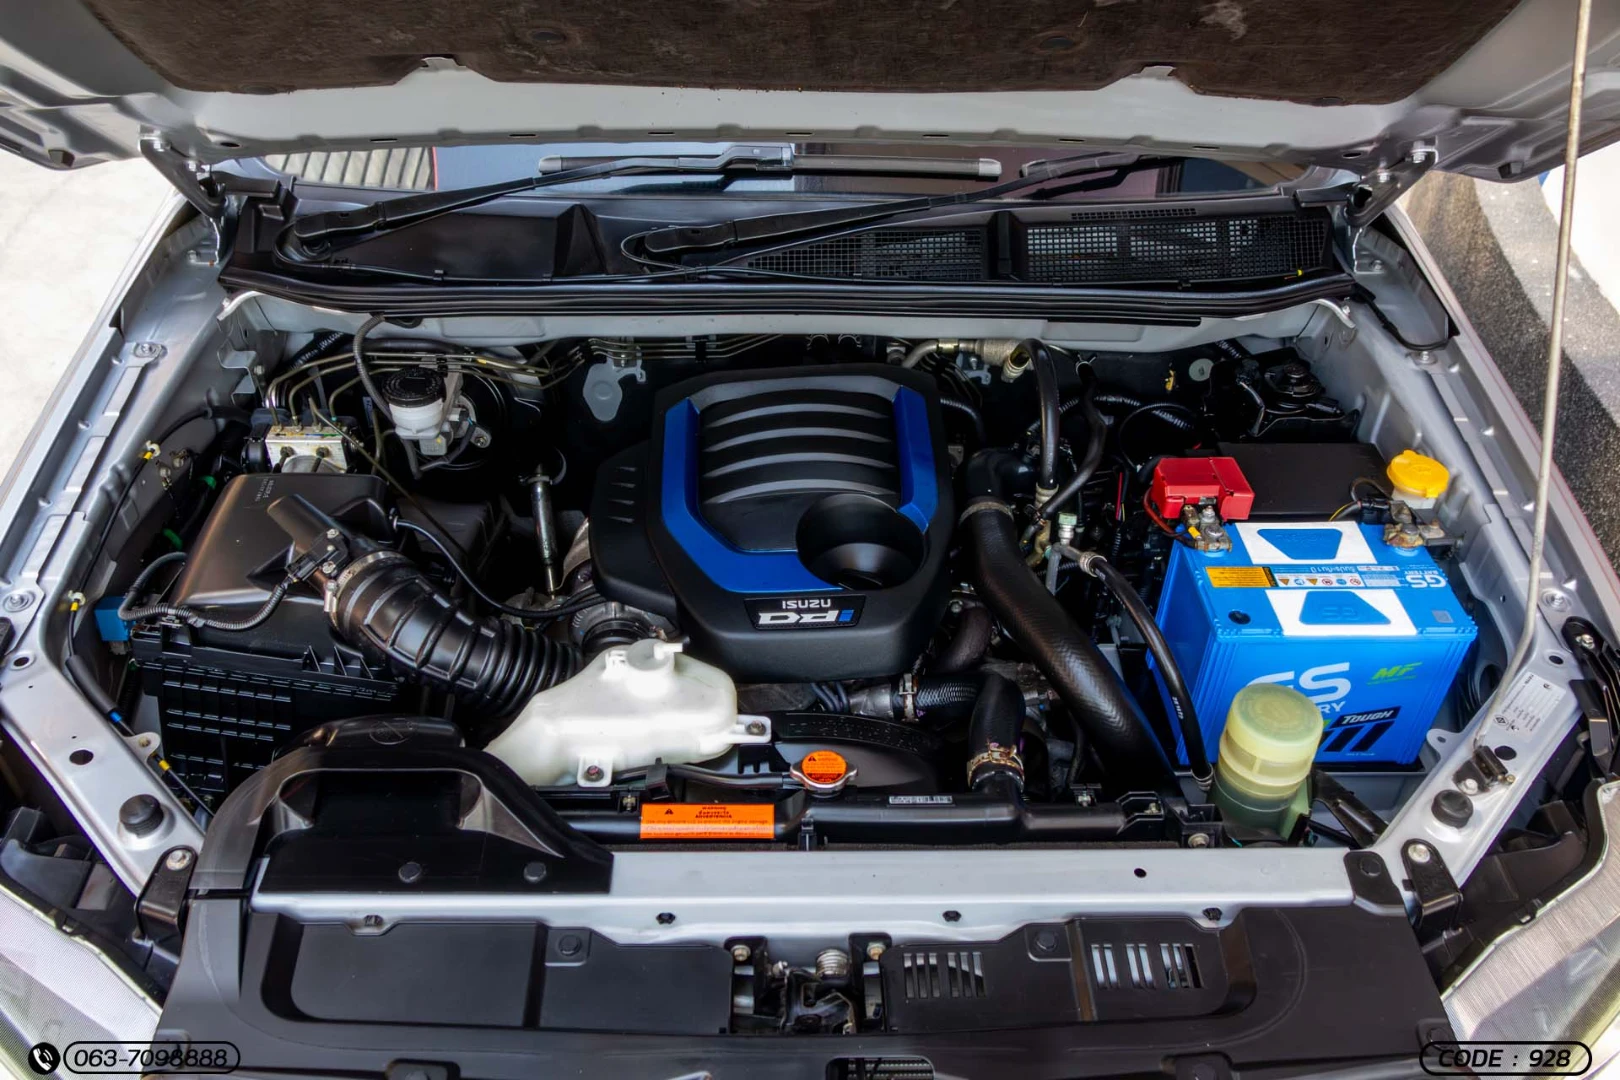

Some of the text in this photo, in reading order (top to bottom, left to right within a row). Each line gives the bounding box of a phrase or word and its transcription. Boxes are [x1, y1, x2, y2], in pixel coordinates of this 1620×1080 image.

[1406, 574, 1447, 588] GS
[782, 598, 831, 609] ISUZU
[1371, 662, 1423, 680] MF
[1341, 710, 1394, 725] TOUGH
